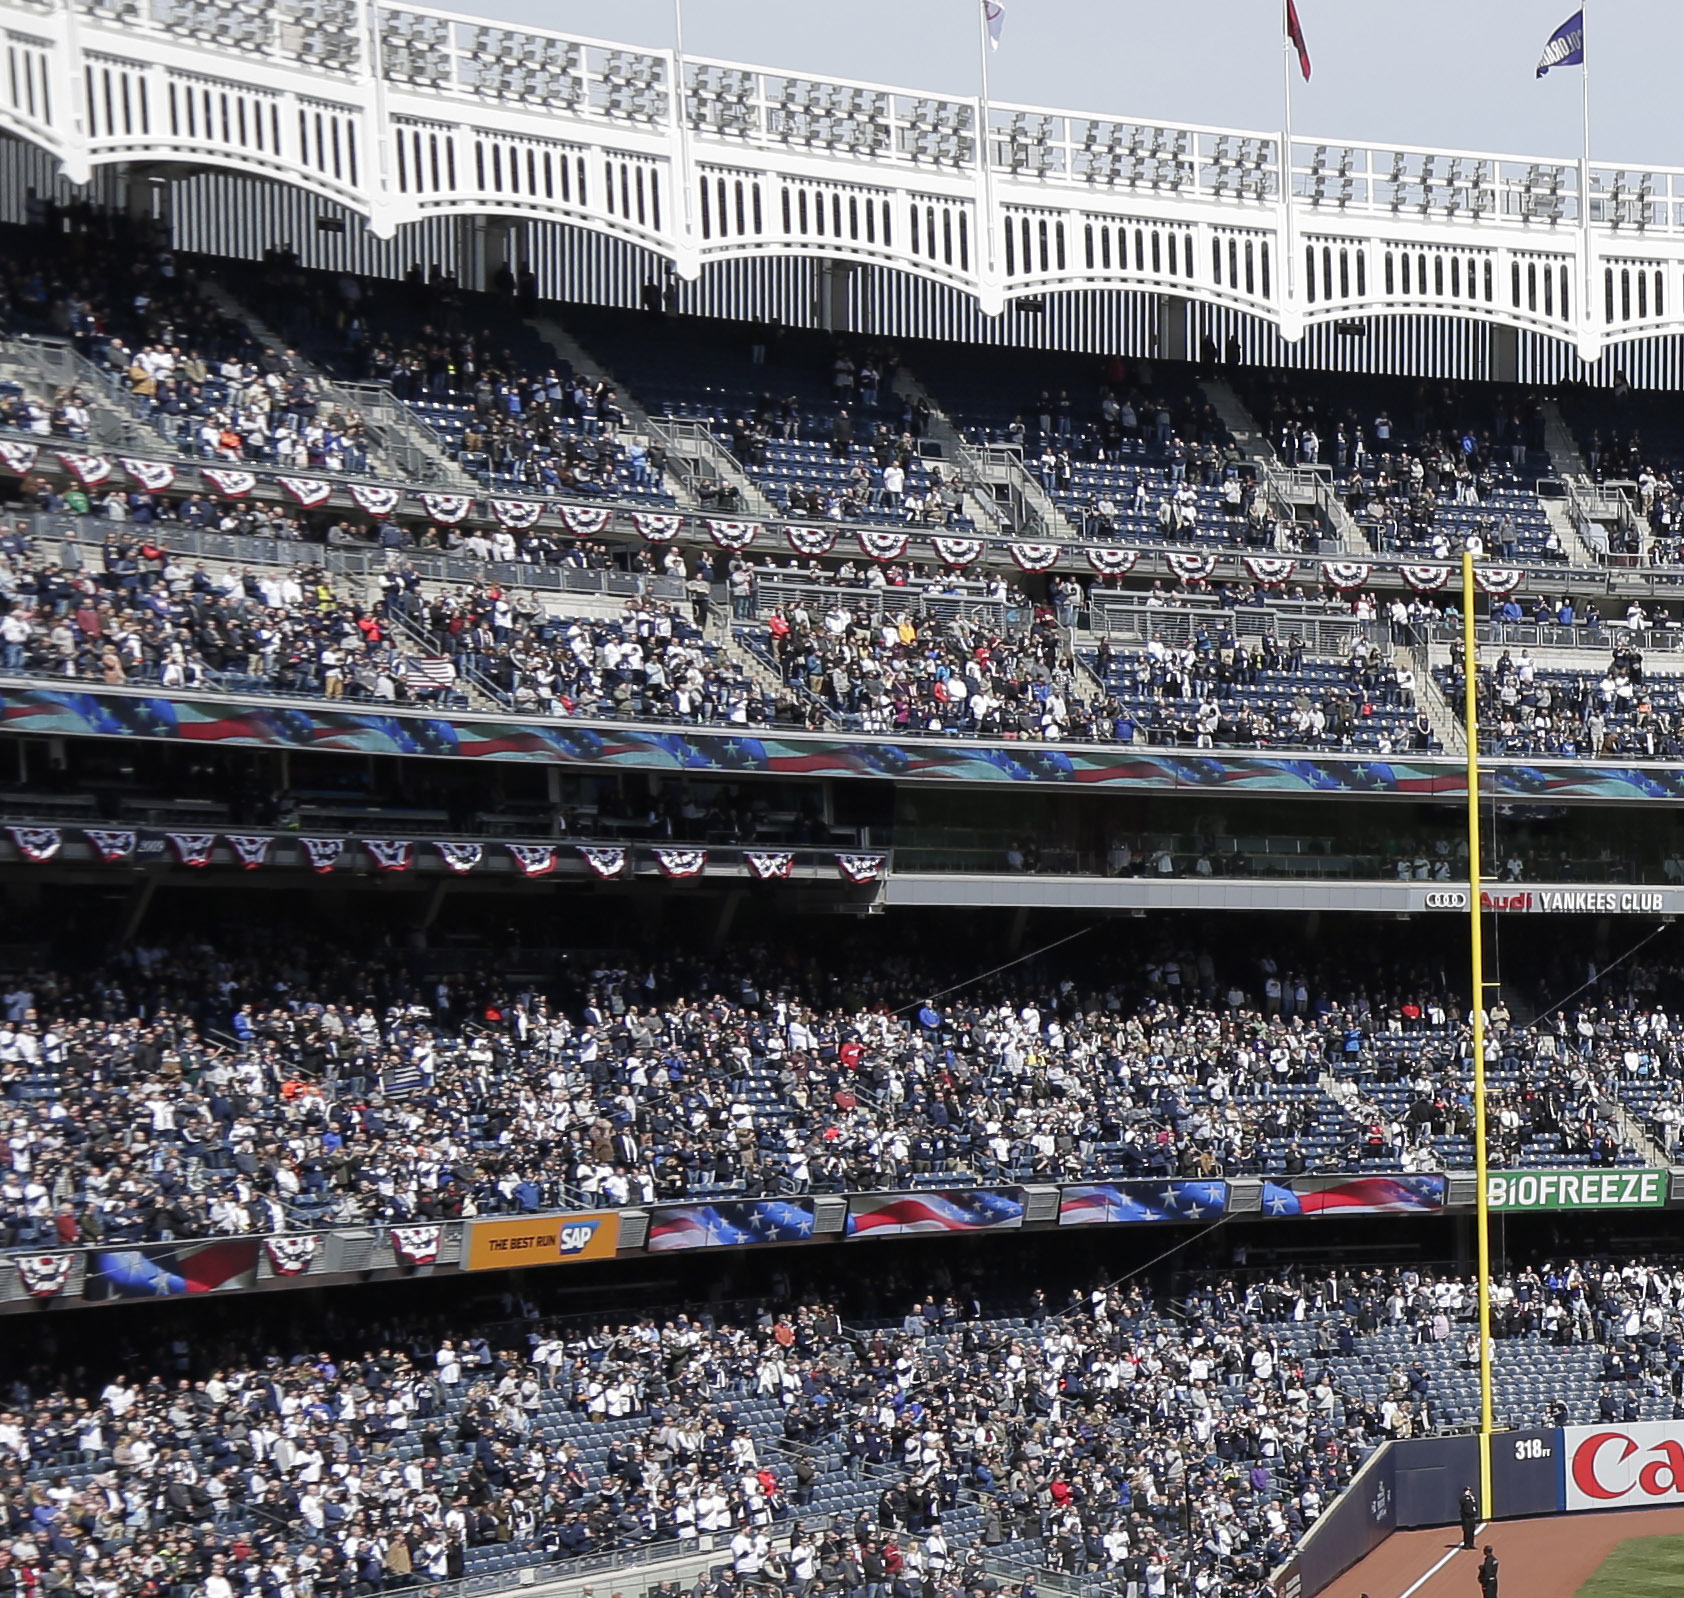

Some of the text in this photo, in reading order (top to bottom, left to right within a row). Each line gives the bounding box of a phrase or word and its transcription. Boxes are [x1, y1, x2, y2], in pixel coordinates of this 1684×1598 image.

[1480, 891, 1664, 911] Audi YANKEES CLUB
[488, 1233, 556, 1252] THE BEST RUN
[560, 1226, 594, 1251] SAP
